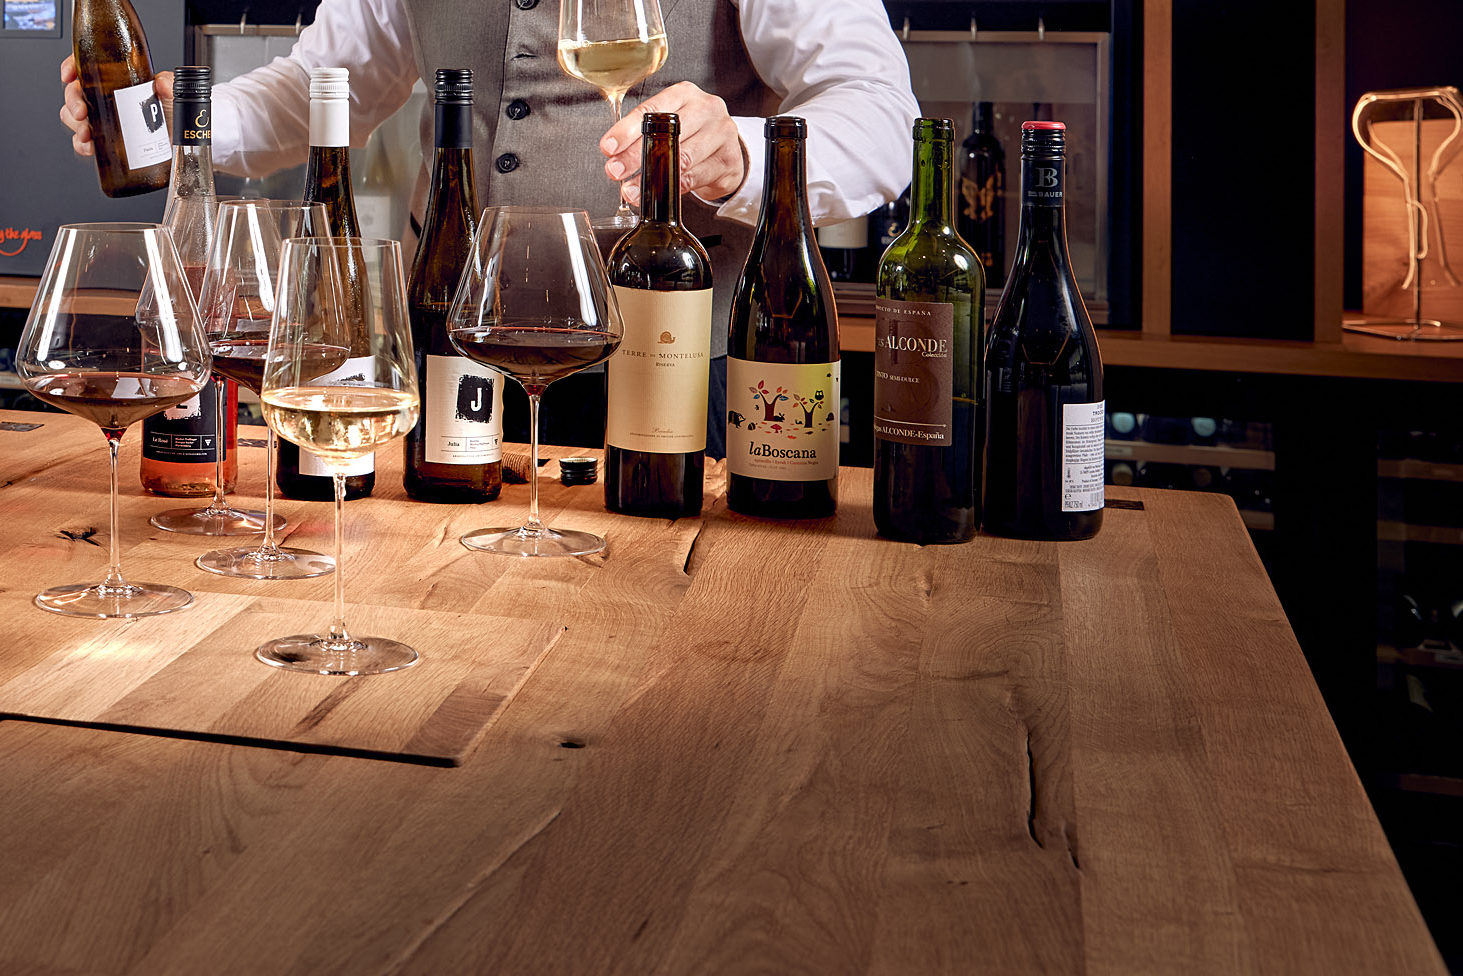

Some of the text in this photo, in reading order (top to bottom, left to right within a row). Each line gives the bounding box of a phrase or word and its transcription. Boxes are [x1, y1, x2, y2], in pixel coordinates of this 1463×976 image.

[150, 103, 158, 123] P
[622, 349, 647, 358] TERRE
[885, 335, 948, 353] ALCONDE
[470, 387, 483, 412] J
